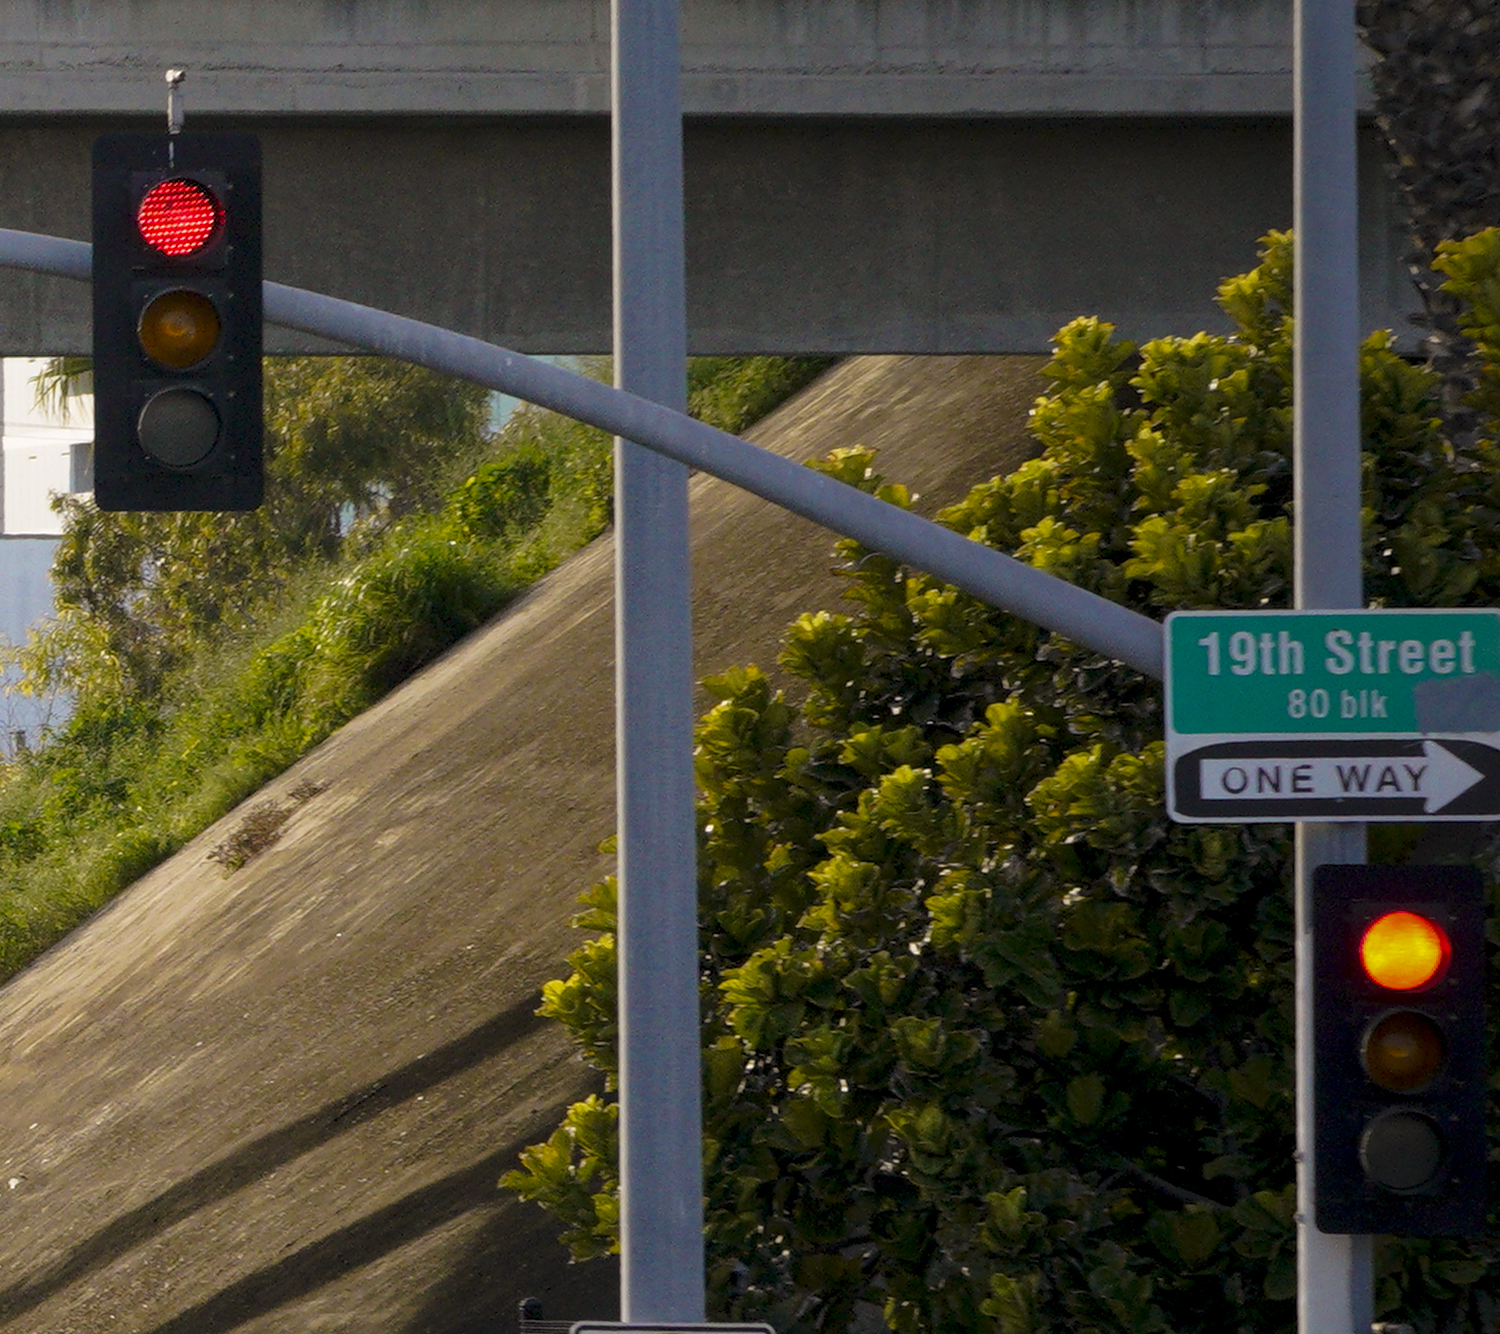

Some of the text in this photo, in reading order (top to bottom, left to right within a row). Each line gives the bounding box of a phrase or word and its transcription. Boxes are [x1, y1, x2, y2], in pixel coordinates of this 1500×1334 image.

[1198, 629, 1477, 676] 19th Street
[1287, 688, 1389, 718] 80 blk
[1221, 763, 1429, 794] ONE WAY
